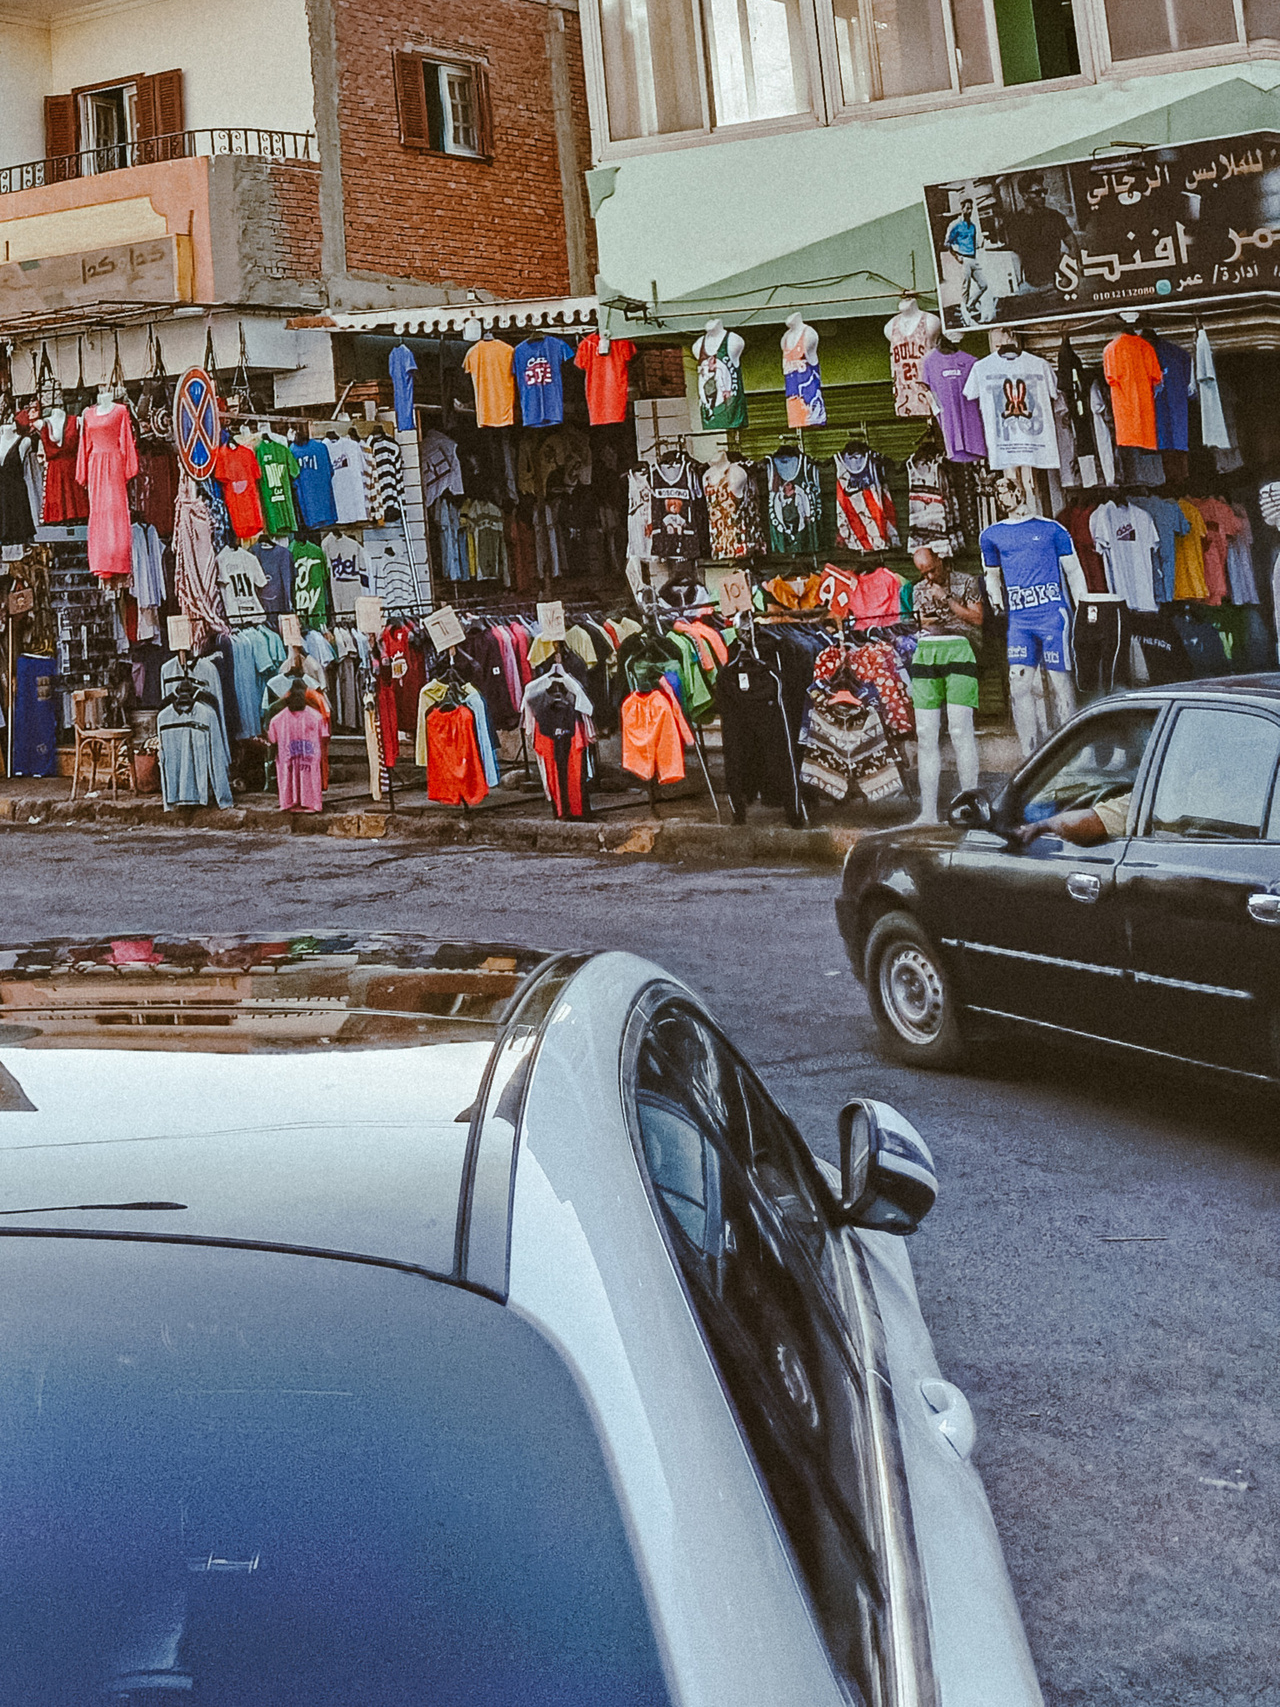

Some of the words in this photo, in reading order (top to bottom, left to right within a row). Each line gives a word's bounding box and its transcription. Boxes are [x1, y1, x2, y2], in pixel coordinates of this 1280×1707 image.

[1087, 164, 1170, 211] الرجالي
[1185, 148, 1263, 190] للملابس
[1055, 221, 1188, 301] افندي
[1223, 226, 1280, 263] مر
[1176, 272, 1204, 292] عمر
[892, 341, 926, 363] BULLS
